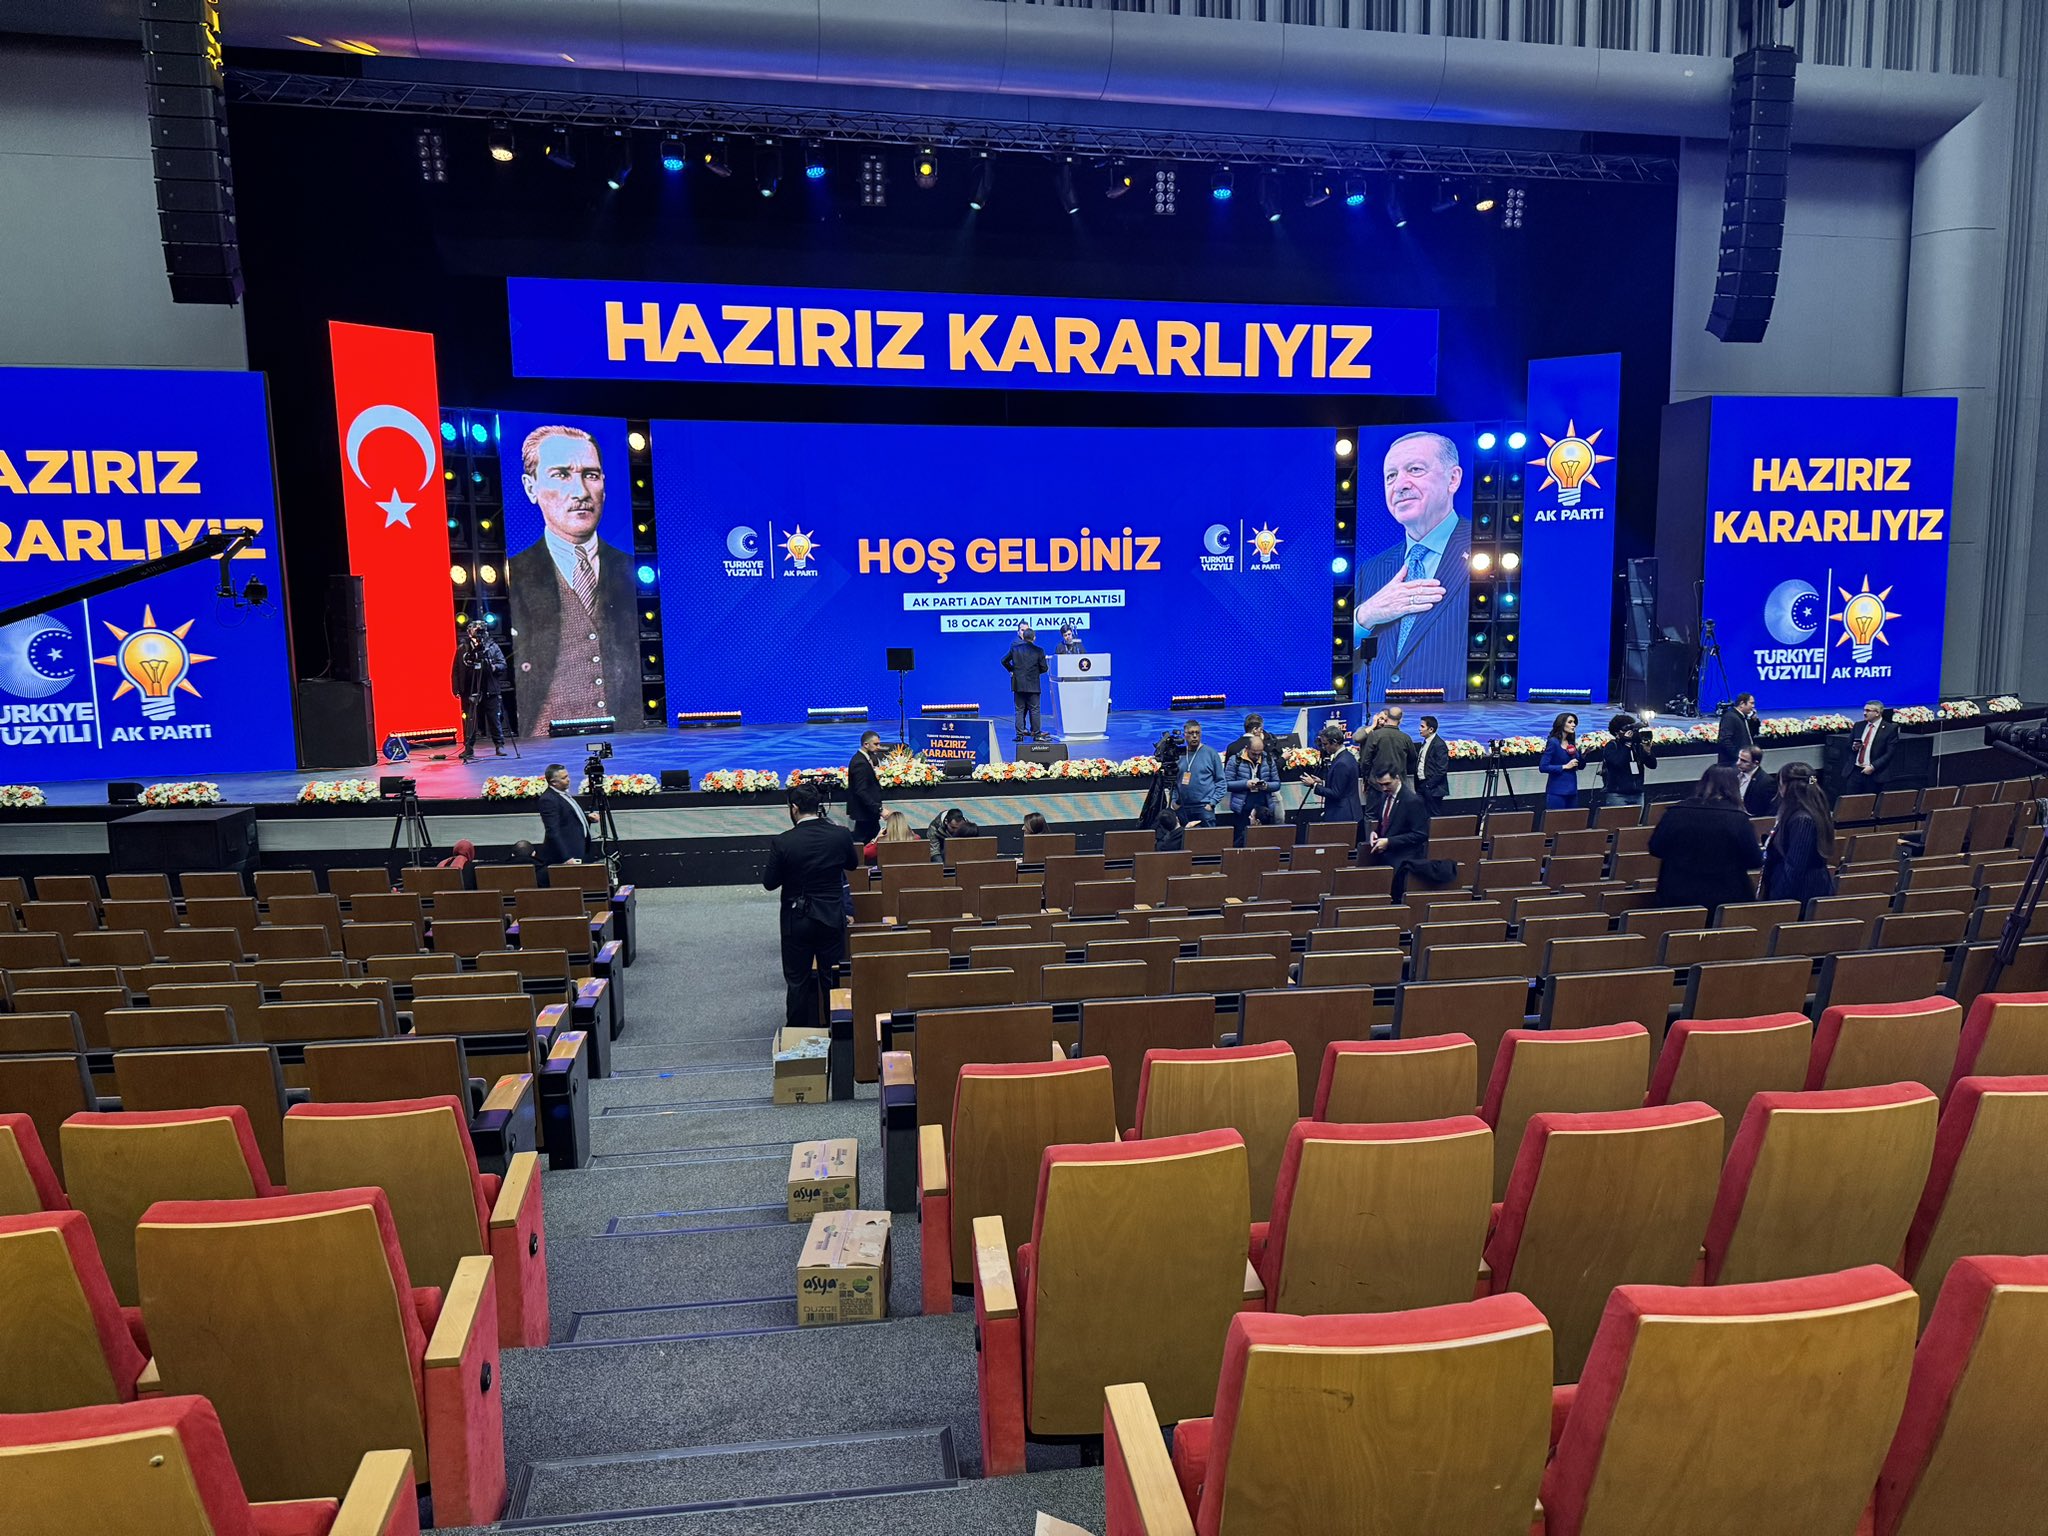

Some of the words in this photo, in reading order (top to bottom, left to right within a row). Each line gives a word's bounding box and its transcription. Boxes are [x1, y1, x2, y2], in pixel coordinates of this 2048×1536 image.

[605, 301, 925, 370] HAZIRIZ
[948, 313, 1373, 379] KARARLIYIZ
[1753, 458, 1911, 492] HAZIRIZ
[1534, 509, 1557, 522] AK
[1713, 509, 1944, 543] KARARLIYIZ
[858, 538, 956, 584] HOŞ
[965, 526, 1161, 574] GELDİNİZ
[783, 569, 795, 577] AK
[912, 597, 930, 607] AK
[970, 597, 1002, 606] ADAY
[1005, 595, 1052, 606] TANITIM
[1055, 594, 1121, 605] TOPLANTISI
[947, 619, 958, 628] 18
[962, 618, 995, 628] OCAK
[1036, 616, 1084, 627] ANKARA
[1831, 666, 1852, 679] AK
[111, 726, 145, 742] AK
[930, 739, 967, 749] HAZIRIZ
[922, 749, 976, 759] KARARLIYIZ
[793, 1186, 822, 1202] asya
[803, 1275, 838, 1295] asya
